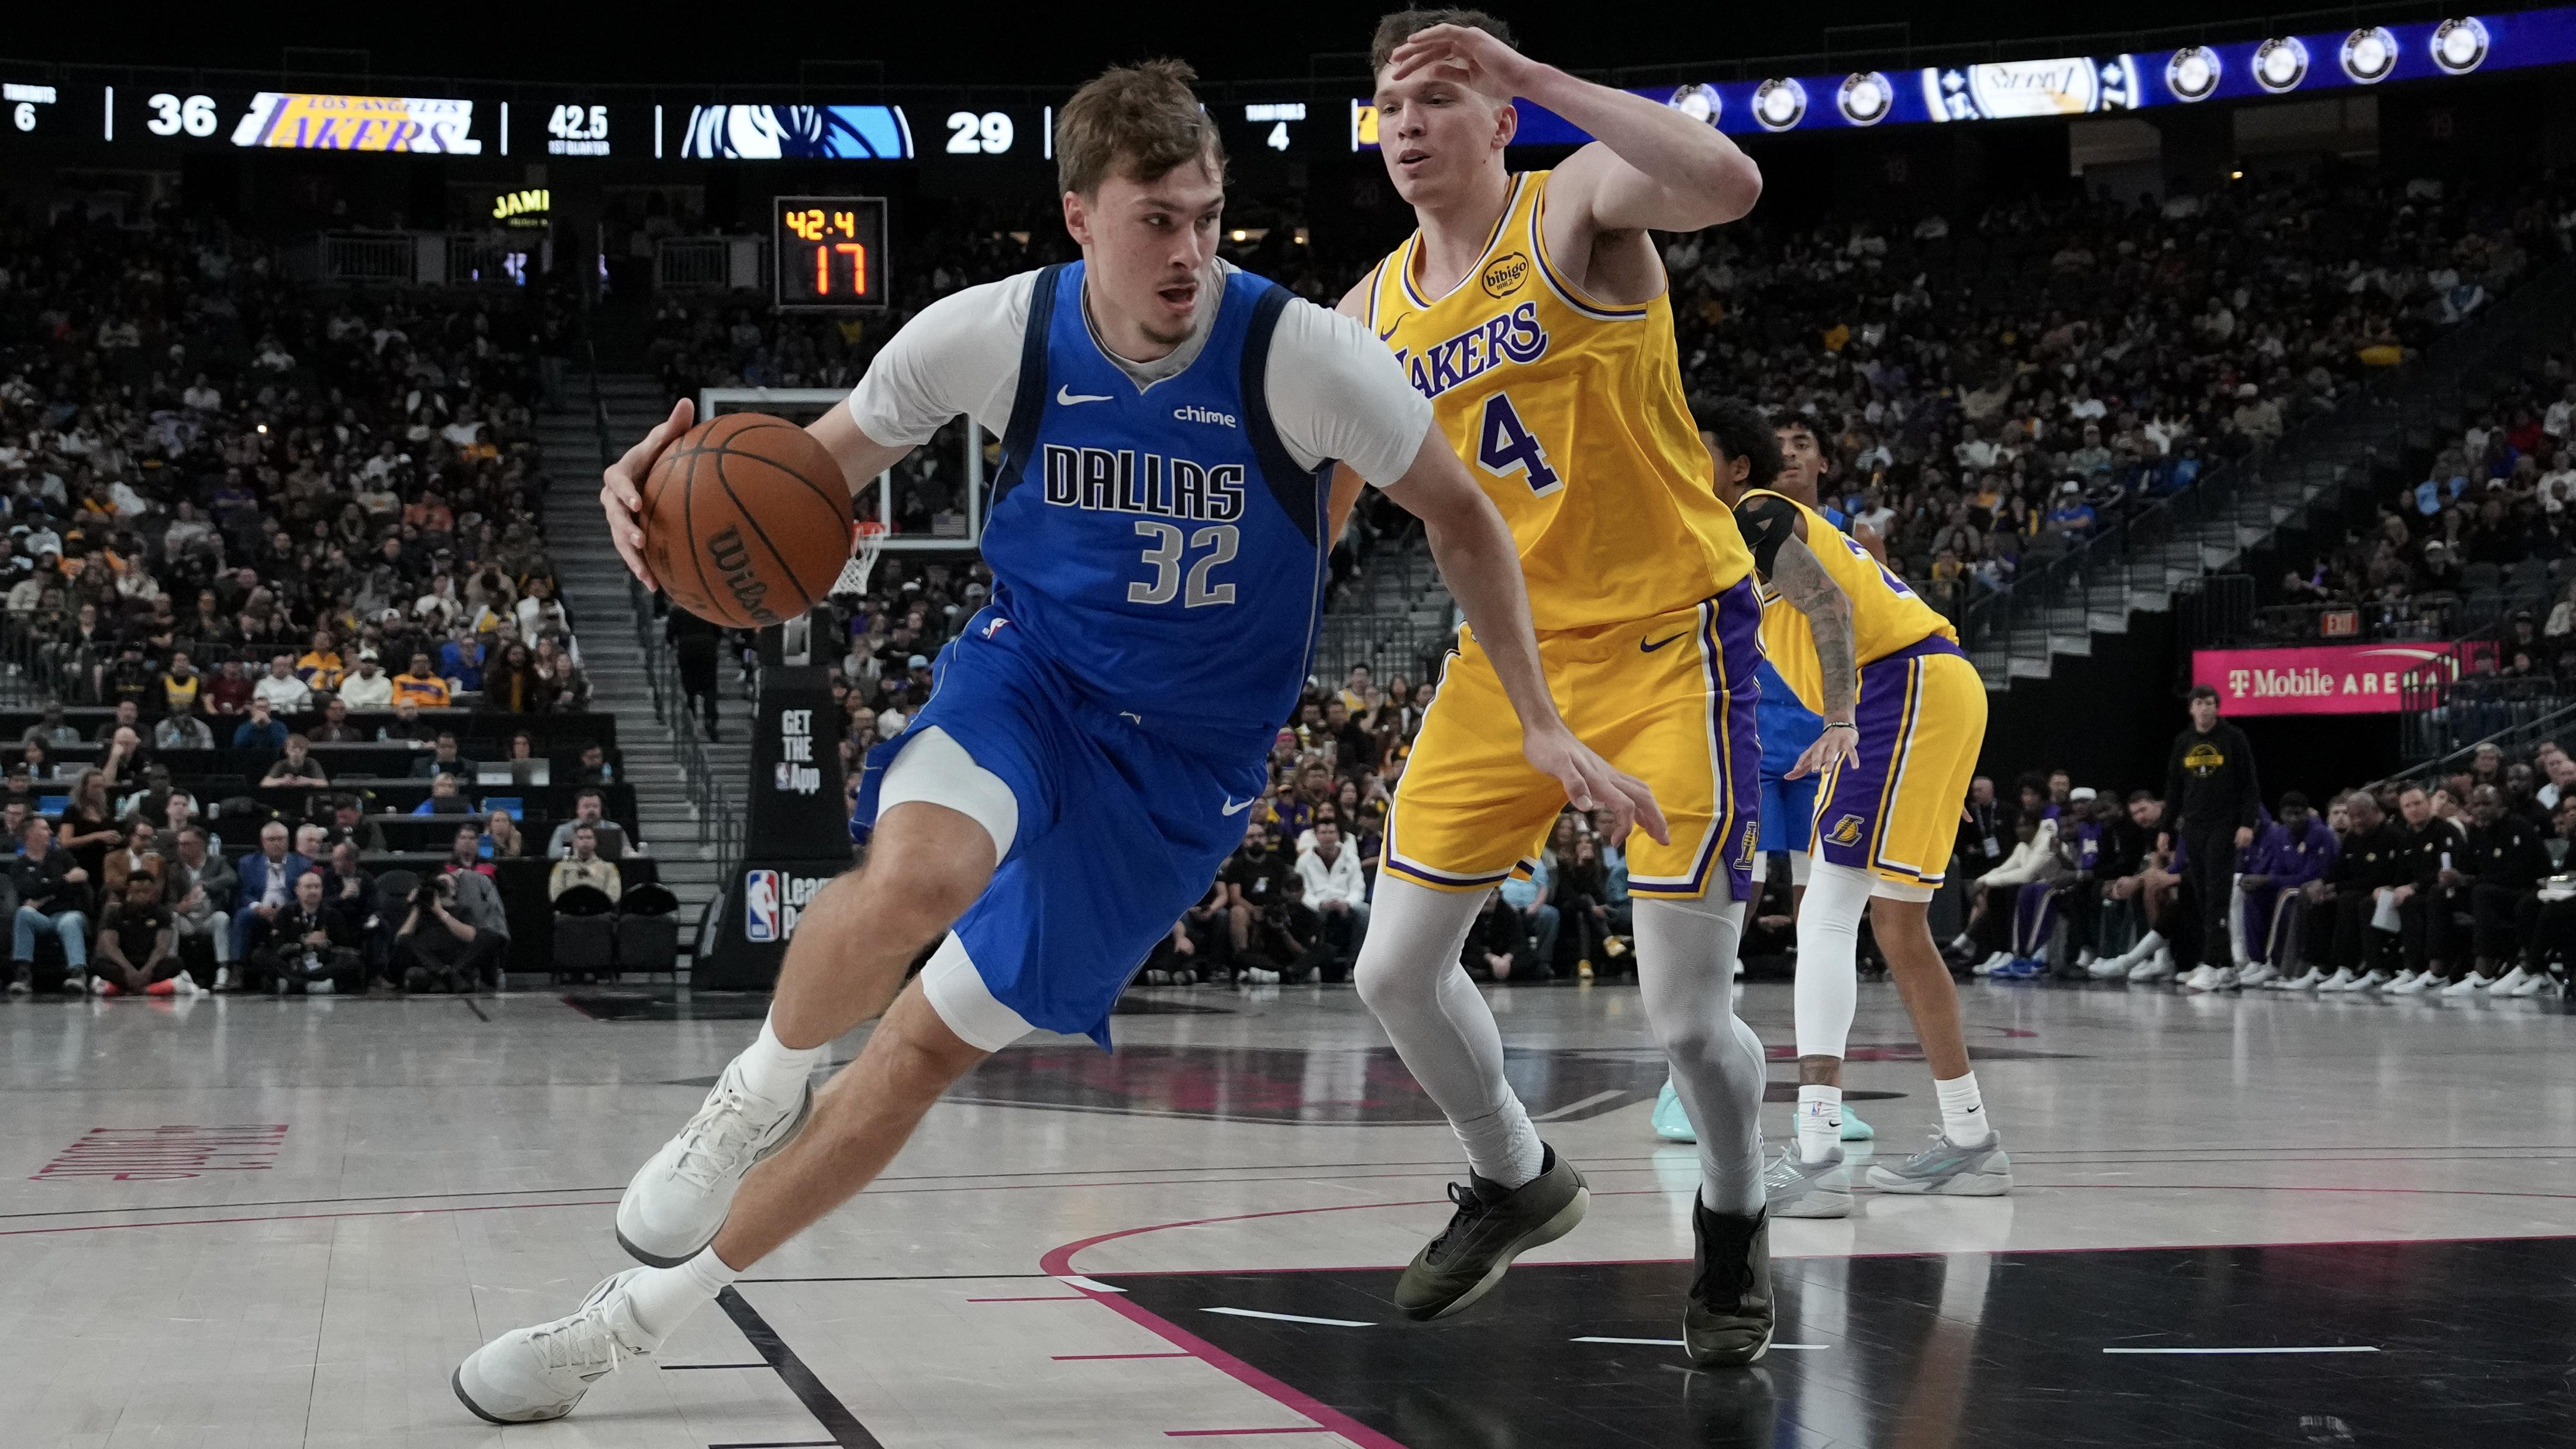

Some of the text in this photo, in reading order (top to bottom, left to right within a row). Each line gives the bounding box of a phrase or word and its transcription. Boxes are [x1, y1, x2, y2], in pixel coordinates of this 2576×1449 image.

[14, 102, 36, 132] 6
[147, 94, 217, 137] 36
[308, 97, 460, 113] LOS ANGELES
[548, 105, 608, 139] 42.5
[946, 111, 1014, 154] 29
[1267, 121, 1290, 152] 4
[548, 140, 610, 156] 1ST QUARTER
[786, 209, 854, 240] 42.4
[817, 243, 866, 295] 17
[1486, 262, 1526, 287] bibigo
[1174, 405, 1236, 428] chime
[1476, 390, 1565, 499] 4
[1044, 443, 1245, 522] DALLAS
[1128, 521, 1239, 608] 32
[2253, 667, 2334, 697] Mobile
[781, 710, 813, 735] GET
[781, 736, 814, 762] THE
[790, 762, 821, 796] App
